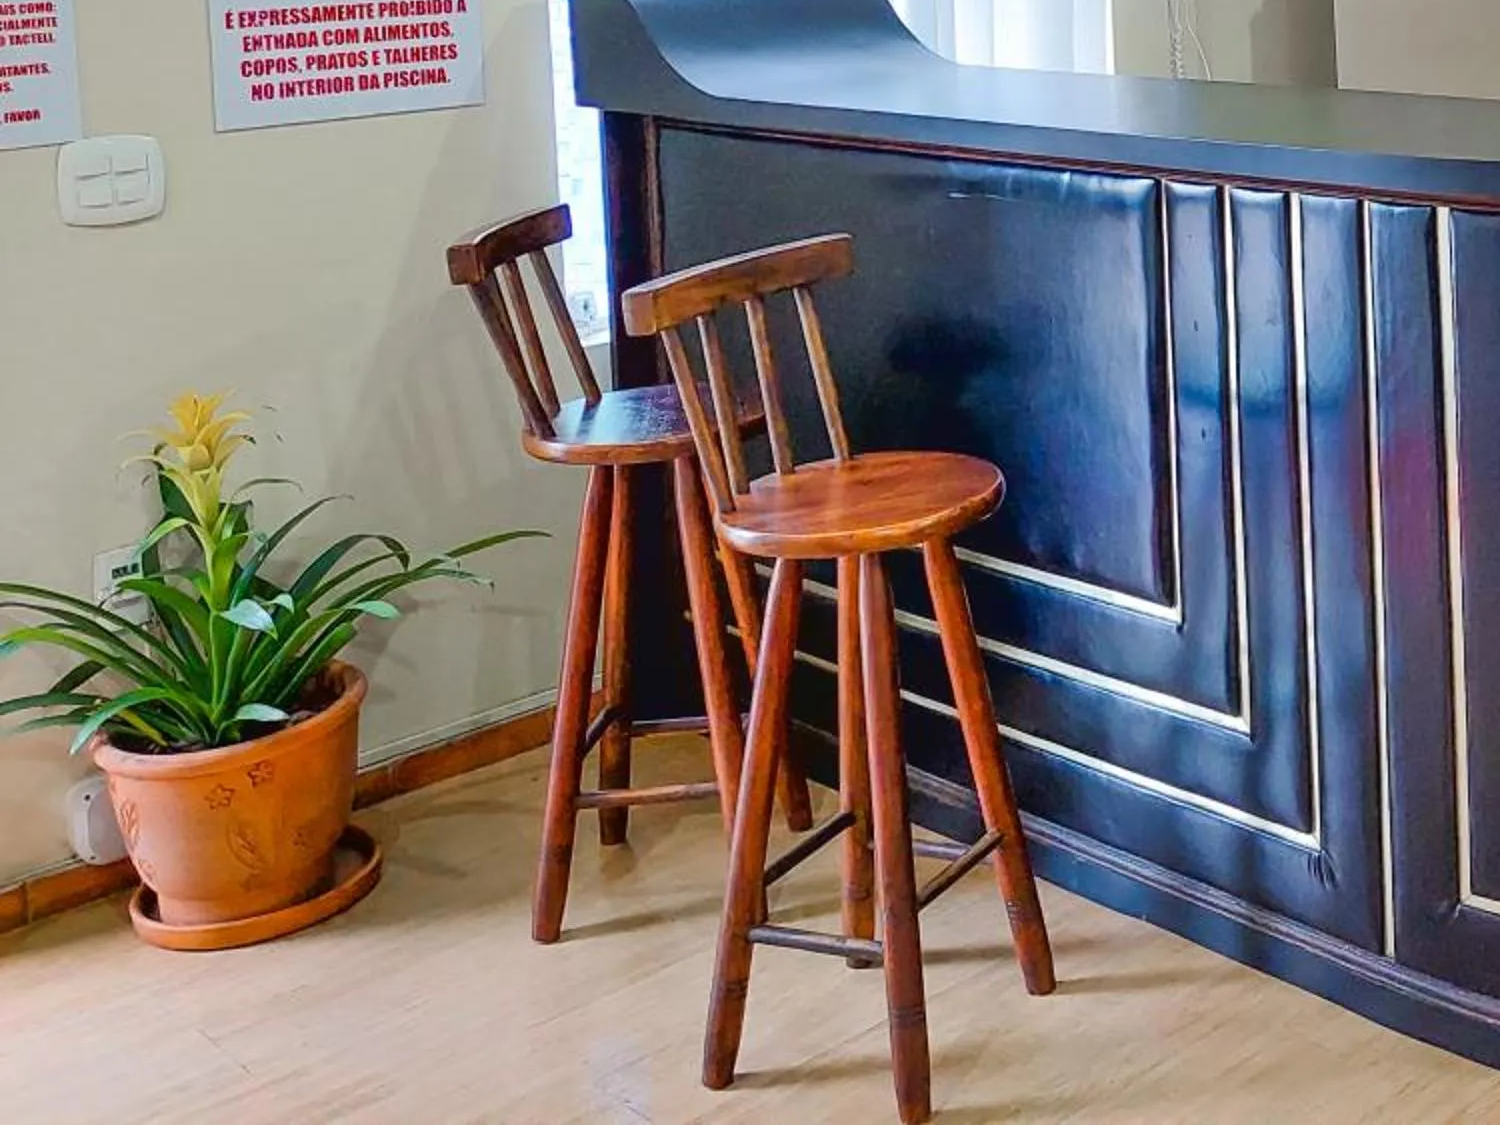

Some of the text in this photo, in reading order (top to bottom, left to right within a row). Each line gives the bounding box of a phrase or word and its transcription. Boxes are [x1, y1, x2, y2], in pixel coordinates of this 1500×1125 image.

[225, 9, 233, 30] É
[238, 3, 374, 29] EXPRESSAMENTE
[243, 29, 319, 53] ENTRADA
[323, 26, 360, 46] COM
[240, 43, 457, 78] COPOS, PRATOS E TALHERES
[251, 67, 451, 101] NO INTERIOR DA PISCINA.
